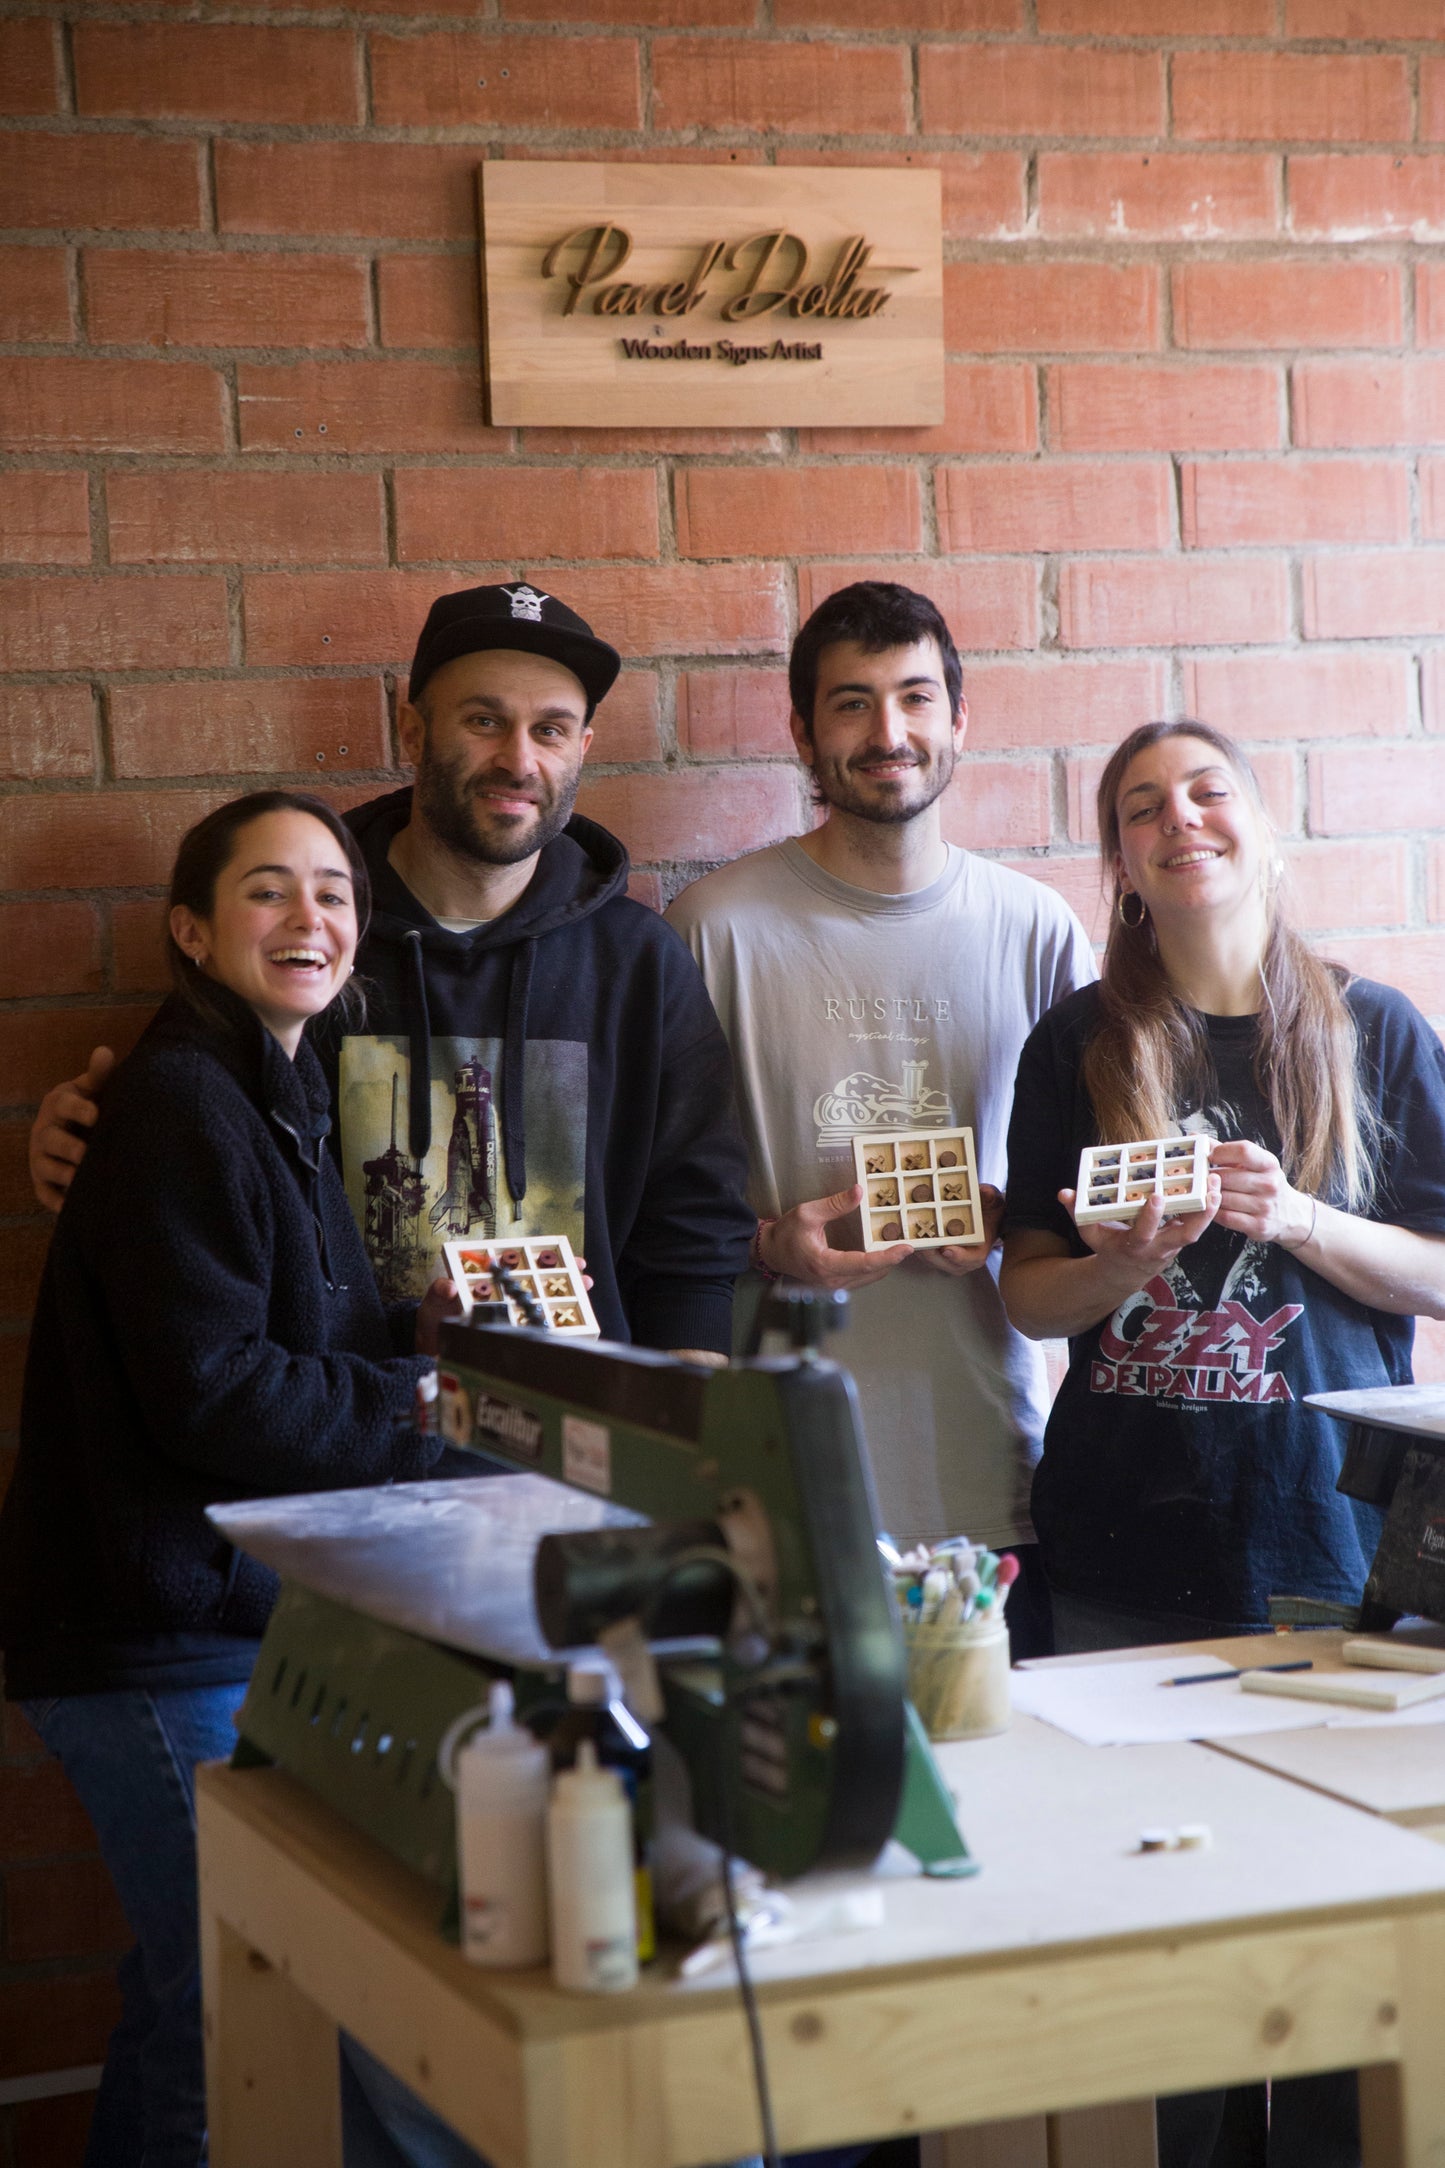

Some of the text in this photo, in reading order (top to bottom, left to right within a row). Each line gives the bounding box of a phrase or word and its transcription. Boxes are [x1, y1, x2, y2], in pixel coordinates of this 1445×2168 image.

[541, 221, 726, 318] Pavel
[622, 338, 824, 366] Wooden Signs Artist
[823, 998, 951, 1022] RUSTLE
[1099, 1274, 1305, 1374] OZZY
[1090, 1360, 1296, 1404] DE PALMA
